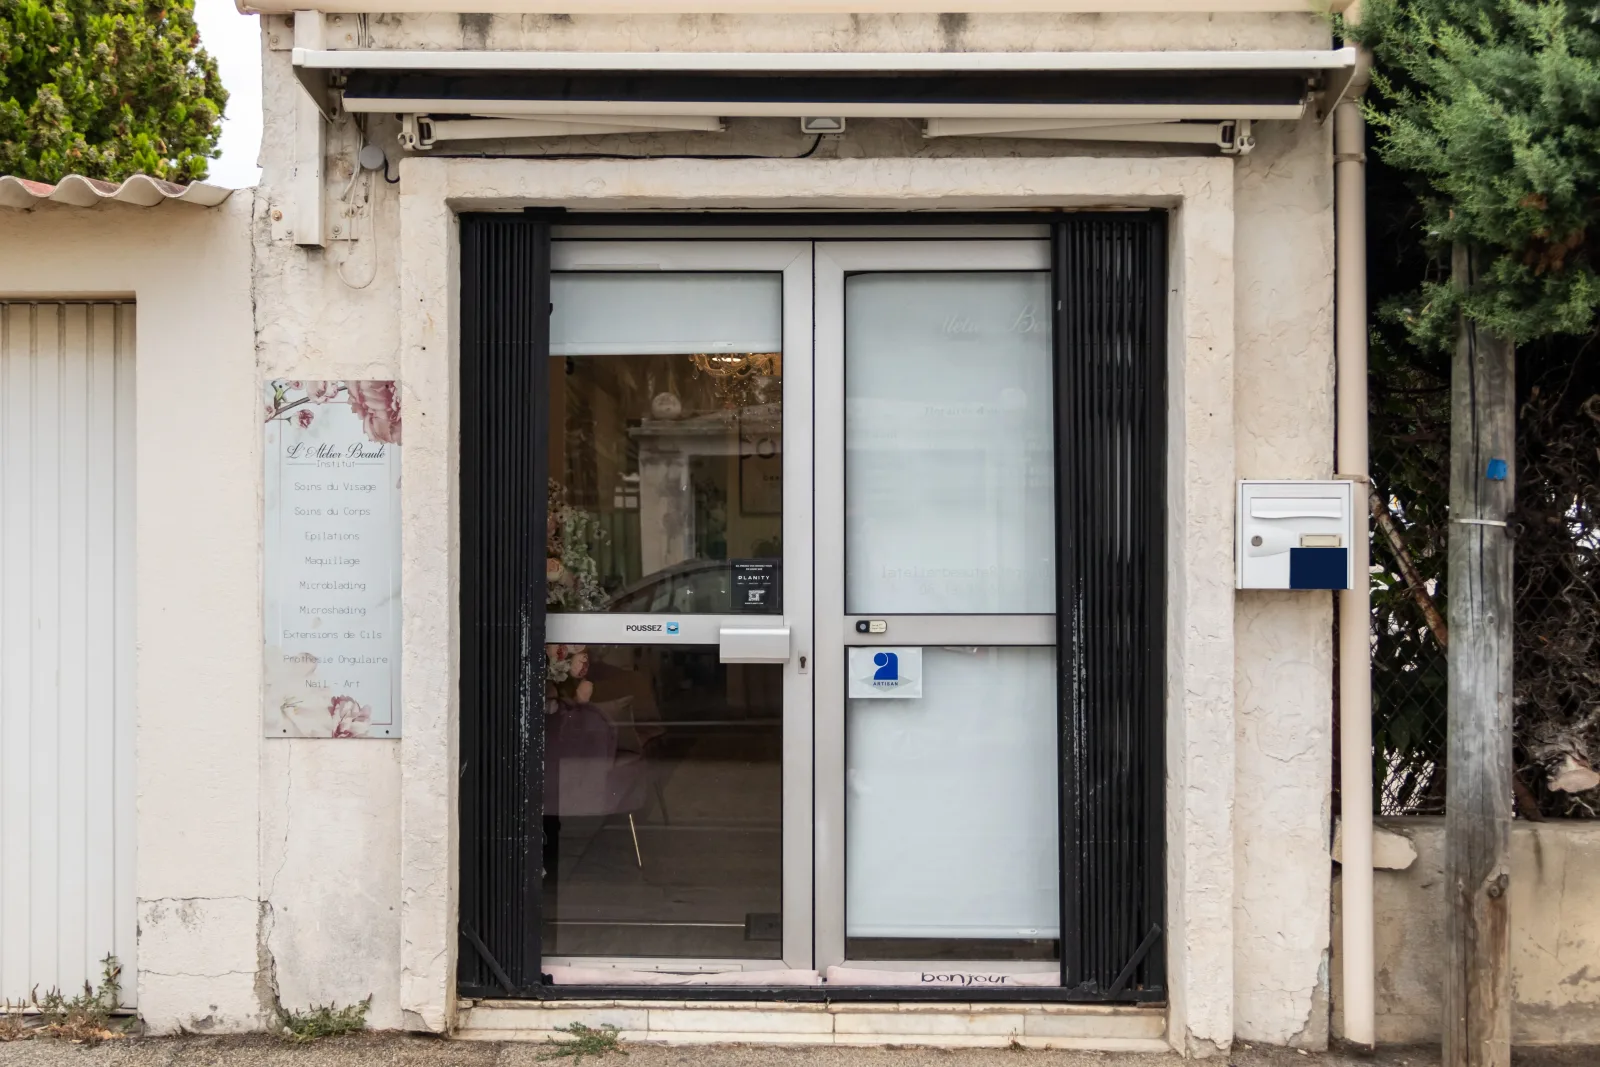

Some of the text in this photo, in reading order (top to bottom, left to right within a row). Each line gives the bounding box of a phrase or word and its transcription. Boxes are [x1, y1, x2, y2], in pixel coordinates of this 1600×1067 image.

[286, 441, 386, 460] L'Atelier Beauté
[316, 459, 355, 468] Institut
[294, 482, 377, 494] Soins du Visage
[294, 507, 371, 517] Soins du Corps
[305, 532, 360, 542] Epilations
[305, 556, 361, 567] Maquillage
[299, 581, 366, 592] Microblading
[299, 606, 367, 617] Microshading
[625, 624, 663, 632] POUSSEZ
[283, 630, 382, 639] Extensions de Cils
[338, 655, 388, 666] Ongulaire
[305, 679, 329, 689] Nail
[343, 679, 361, 689] Art
[921, 972, 1010, 986] bonjour
